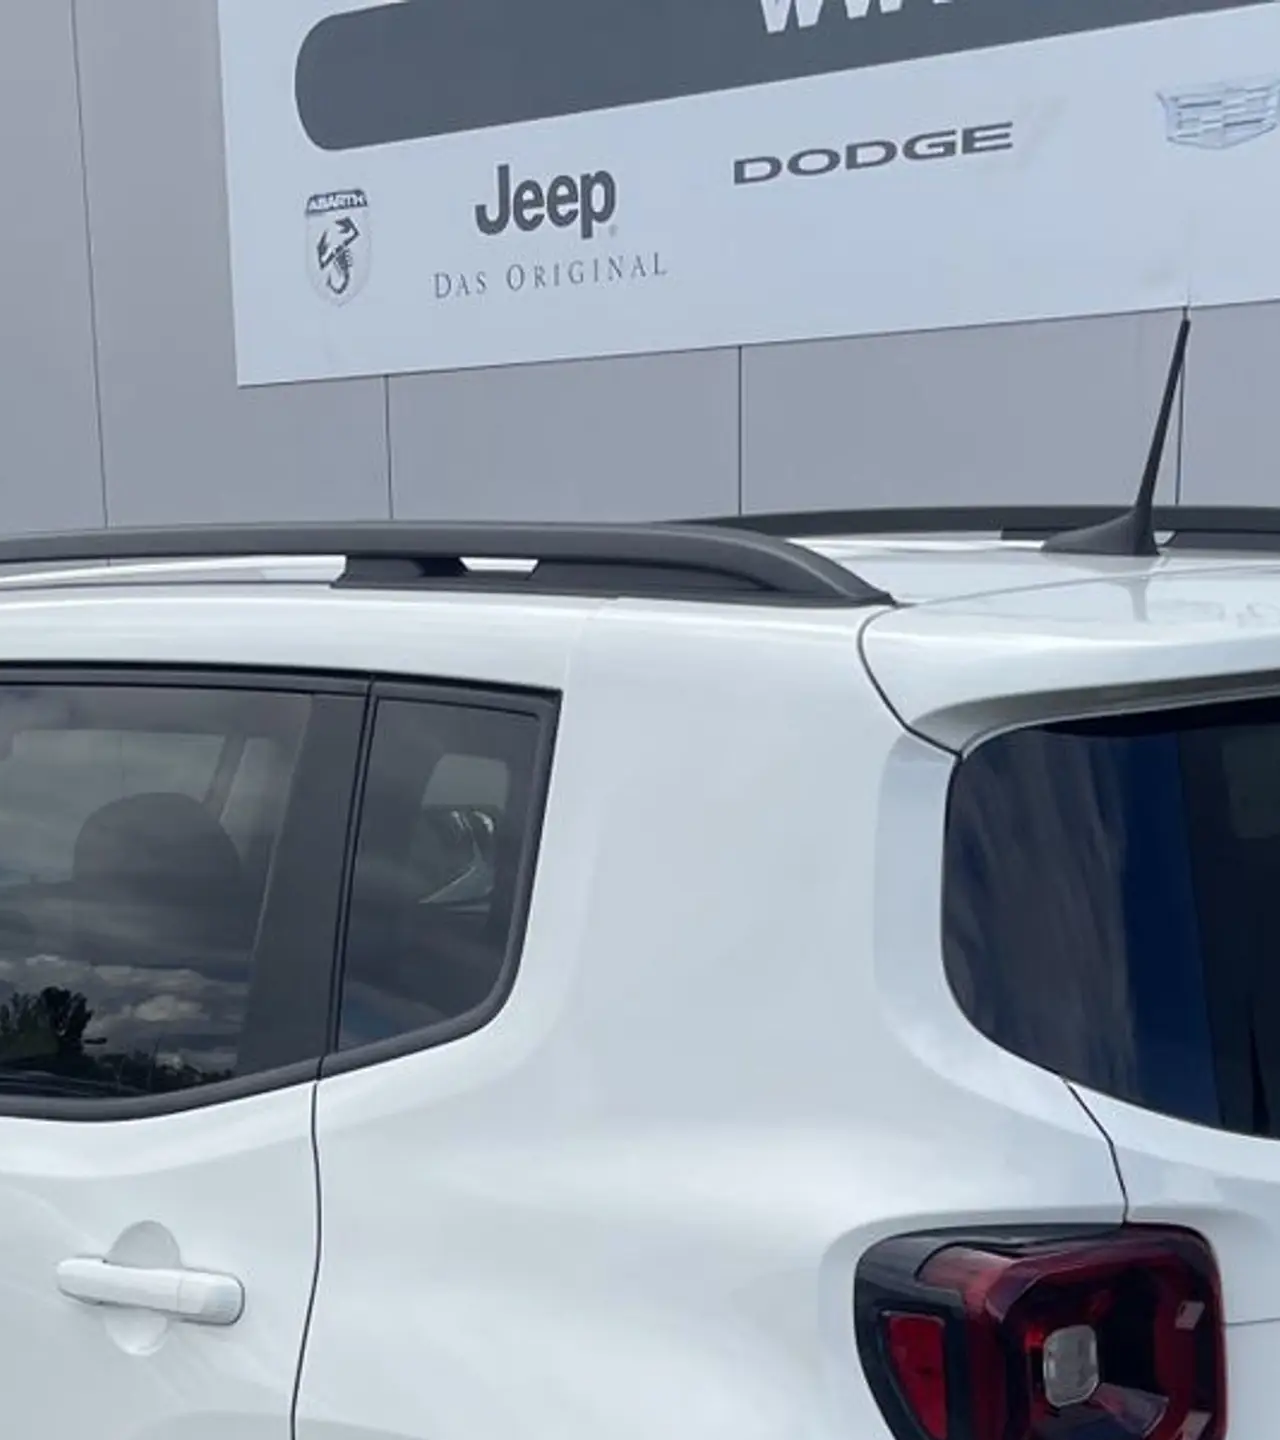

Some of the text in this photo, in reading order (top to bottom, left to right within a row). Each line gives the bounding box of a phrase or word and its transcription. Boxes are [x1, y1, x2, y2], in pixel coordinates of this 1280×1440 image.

[733, 121, 1013, 185] DODGE
[475, 163, 617, 240] Jeep
[432, 252, 668, 299] DAS ORIGINAL
